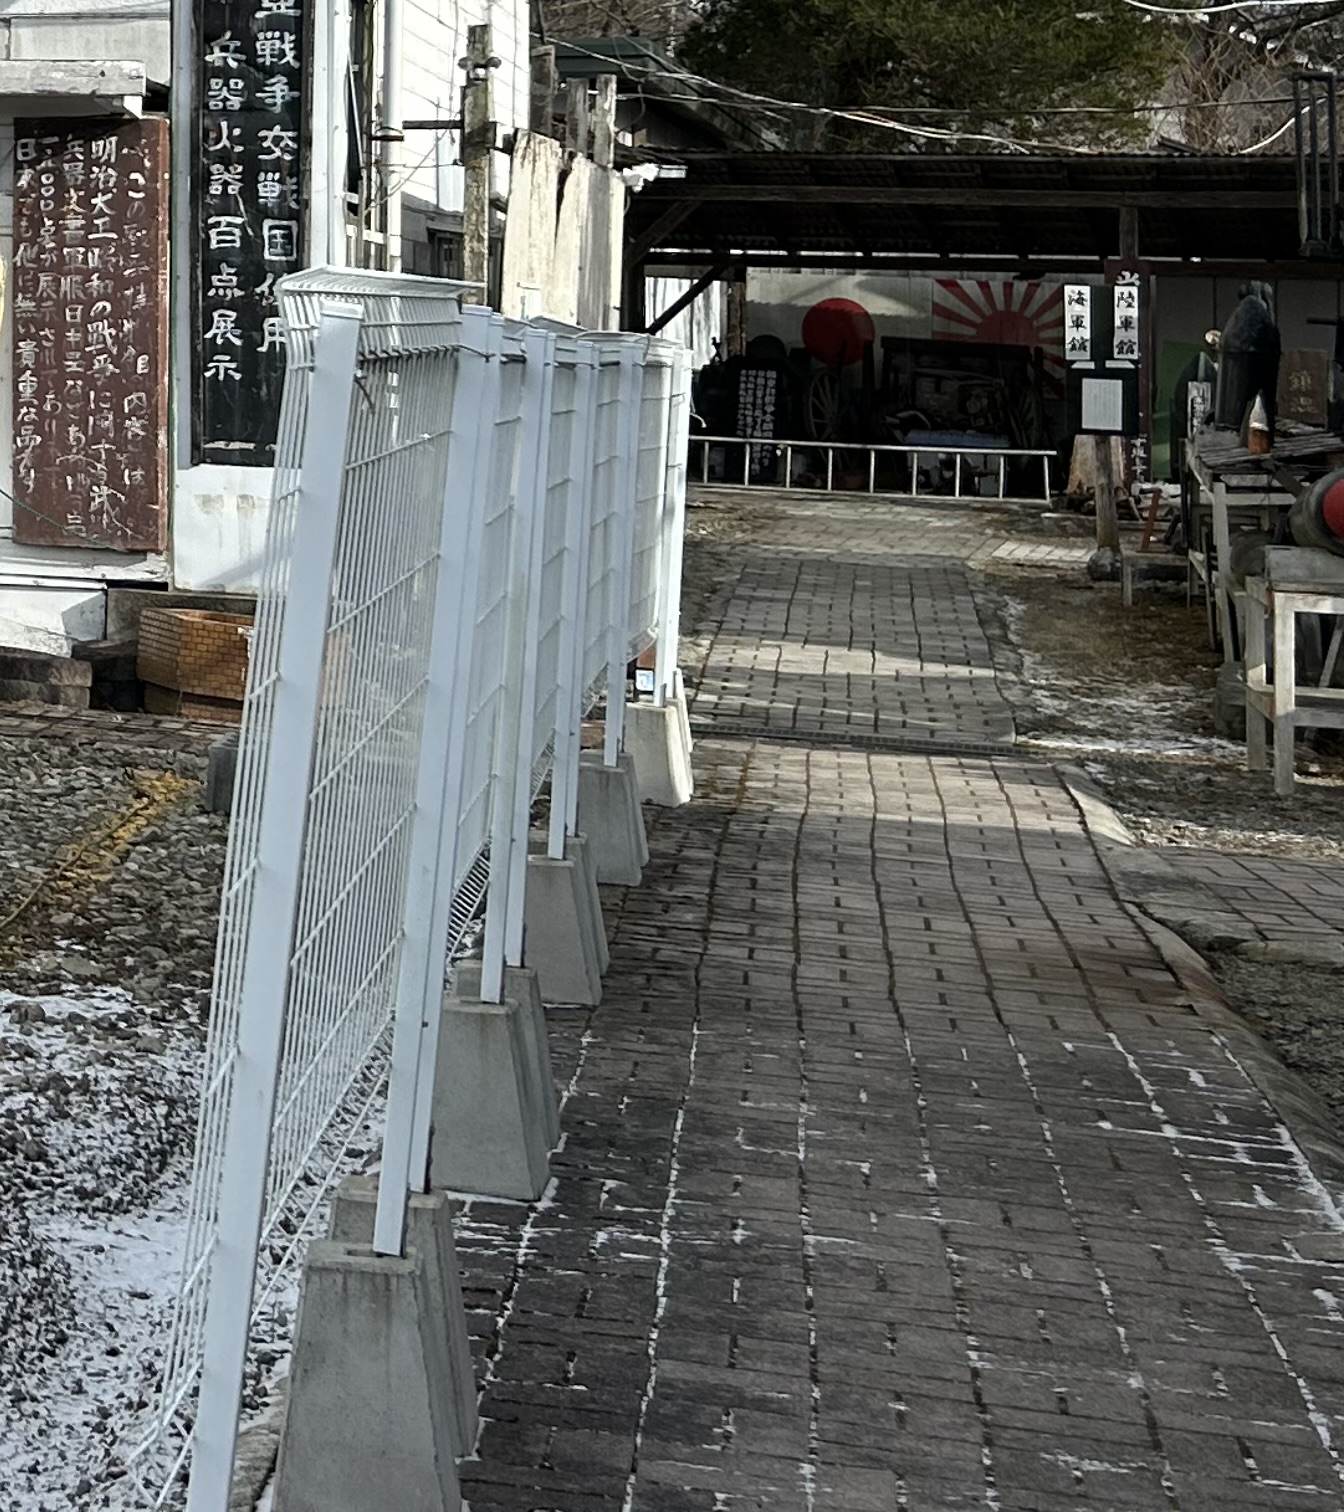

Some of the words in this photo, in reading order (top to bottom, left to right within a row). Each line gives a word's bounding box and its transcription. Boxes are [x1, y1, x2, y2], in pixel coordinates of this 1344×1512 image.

[203, 30, 247, 381] 兵器火器百点展示
